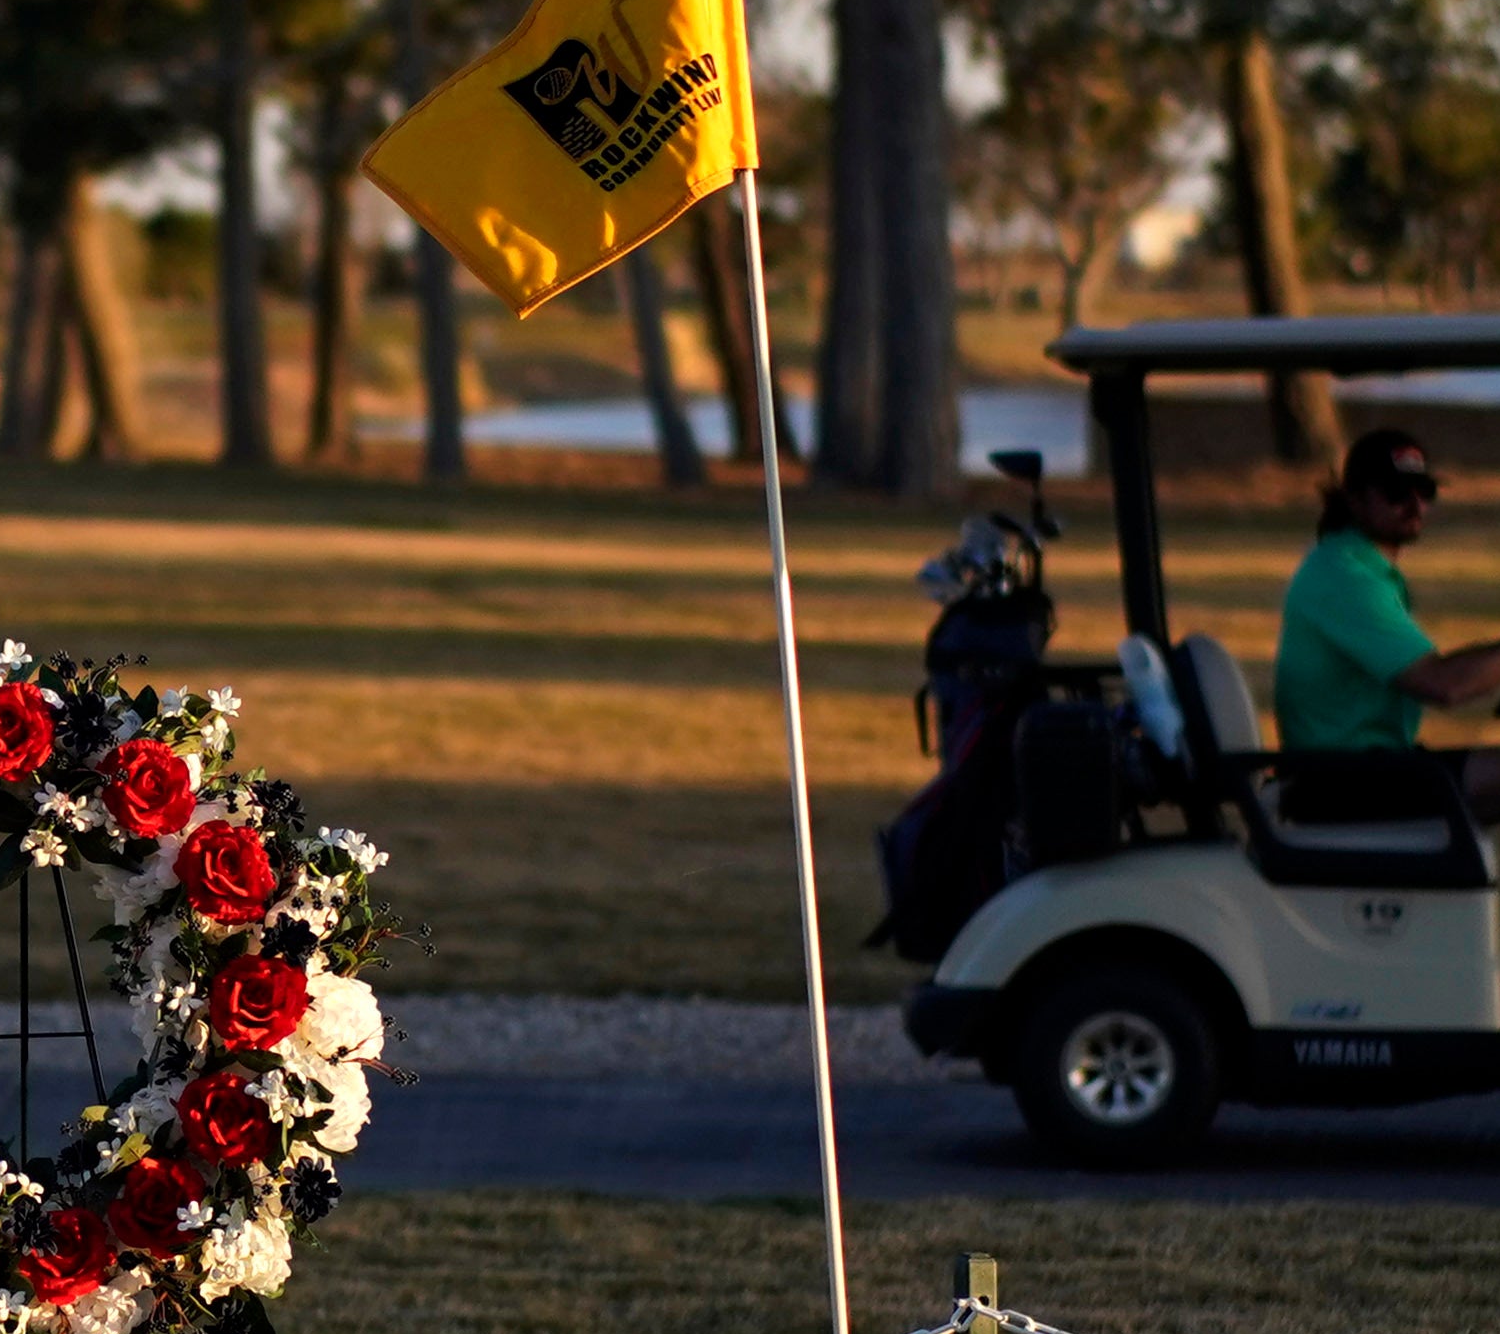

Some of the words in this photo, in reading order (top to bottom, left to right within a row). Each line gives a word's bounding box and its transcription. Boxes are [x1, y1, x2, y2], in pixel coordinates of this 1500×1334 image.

[579, 53, 718, 181] ROCKWIND
[600, 104, 696, 192] COMMUNITY
[694, 87, 722, 112] LIN
[1294, 1039, 1393, 1066] YAMAHA
